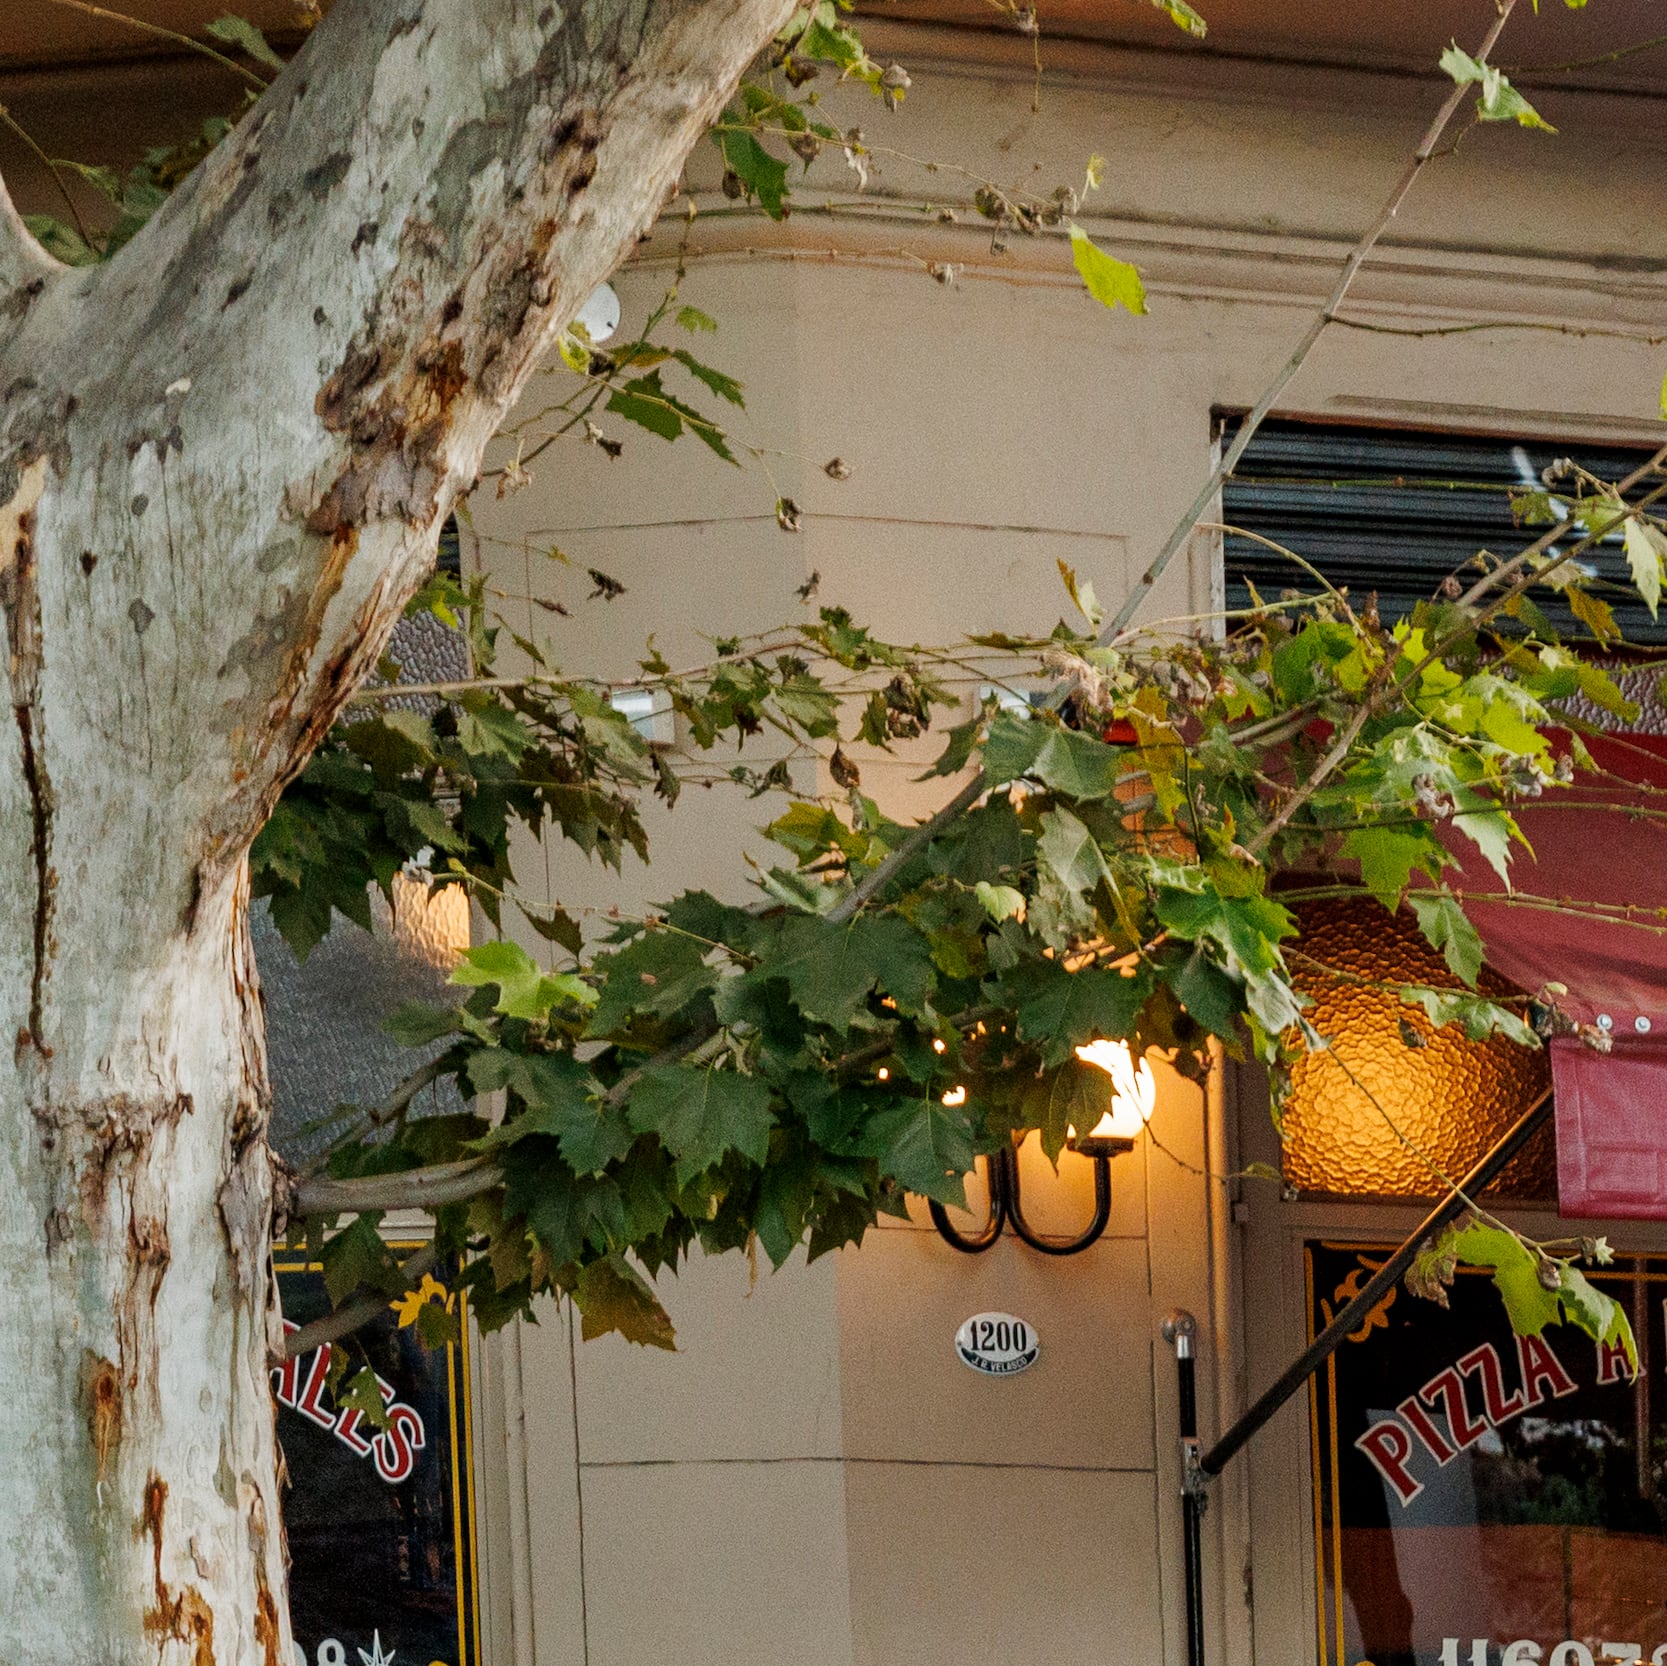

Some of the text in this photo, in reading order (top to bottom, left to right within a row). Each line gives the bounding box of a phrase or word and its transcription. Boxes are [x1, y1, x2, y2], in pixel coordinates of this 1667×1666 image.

[970, 1320, 1027, 1352] 1200
[1354, 1331, 1579, 1508] PIZZA
[1596, 1332, 1648, 1385] A
